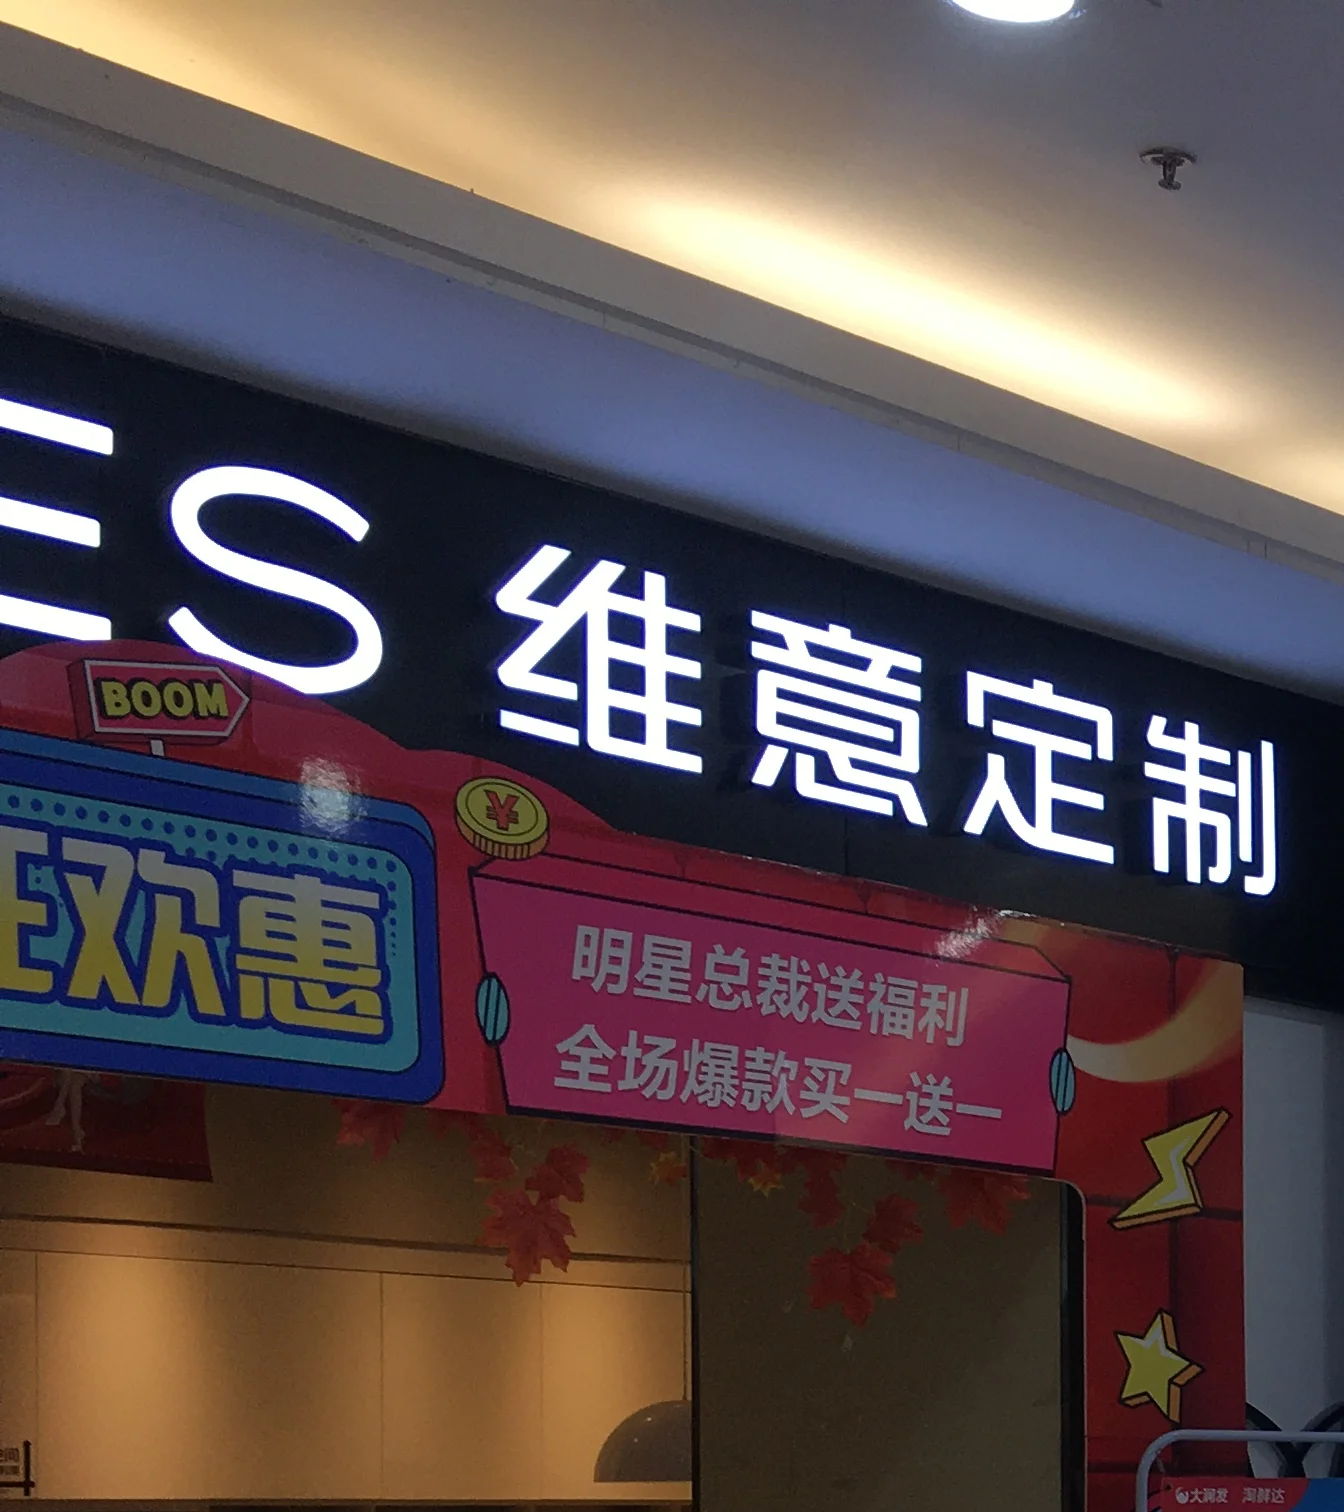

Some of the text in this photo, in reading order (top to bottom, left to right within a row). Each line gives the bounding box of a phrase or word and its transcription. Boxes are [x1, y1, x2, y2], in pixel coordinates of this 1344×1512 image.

[103, 678, 229, 719] BOOM
[495, 544, 1276, 896] 维意定制
[571, 924, 969, 1048] 明星总裁送福利
[554, 1025, 1003, 1137] 全场爆款买一送一
[1190, 1487, 1228, 1503] 大润发
